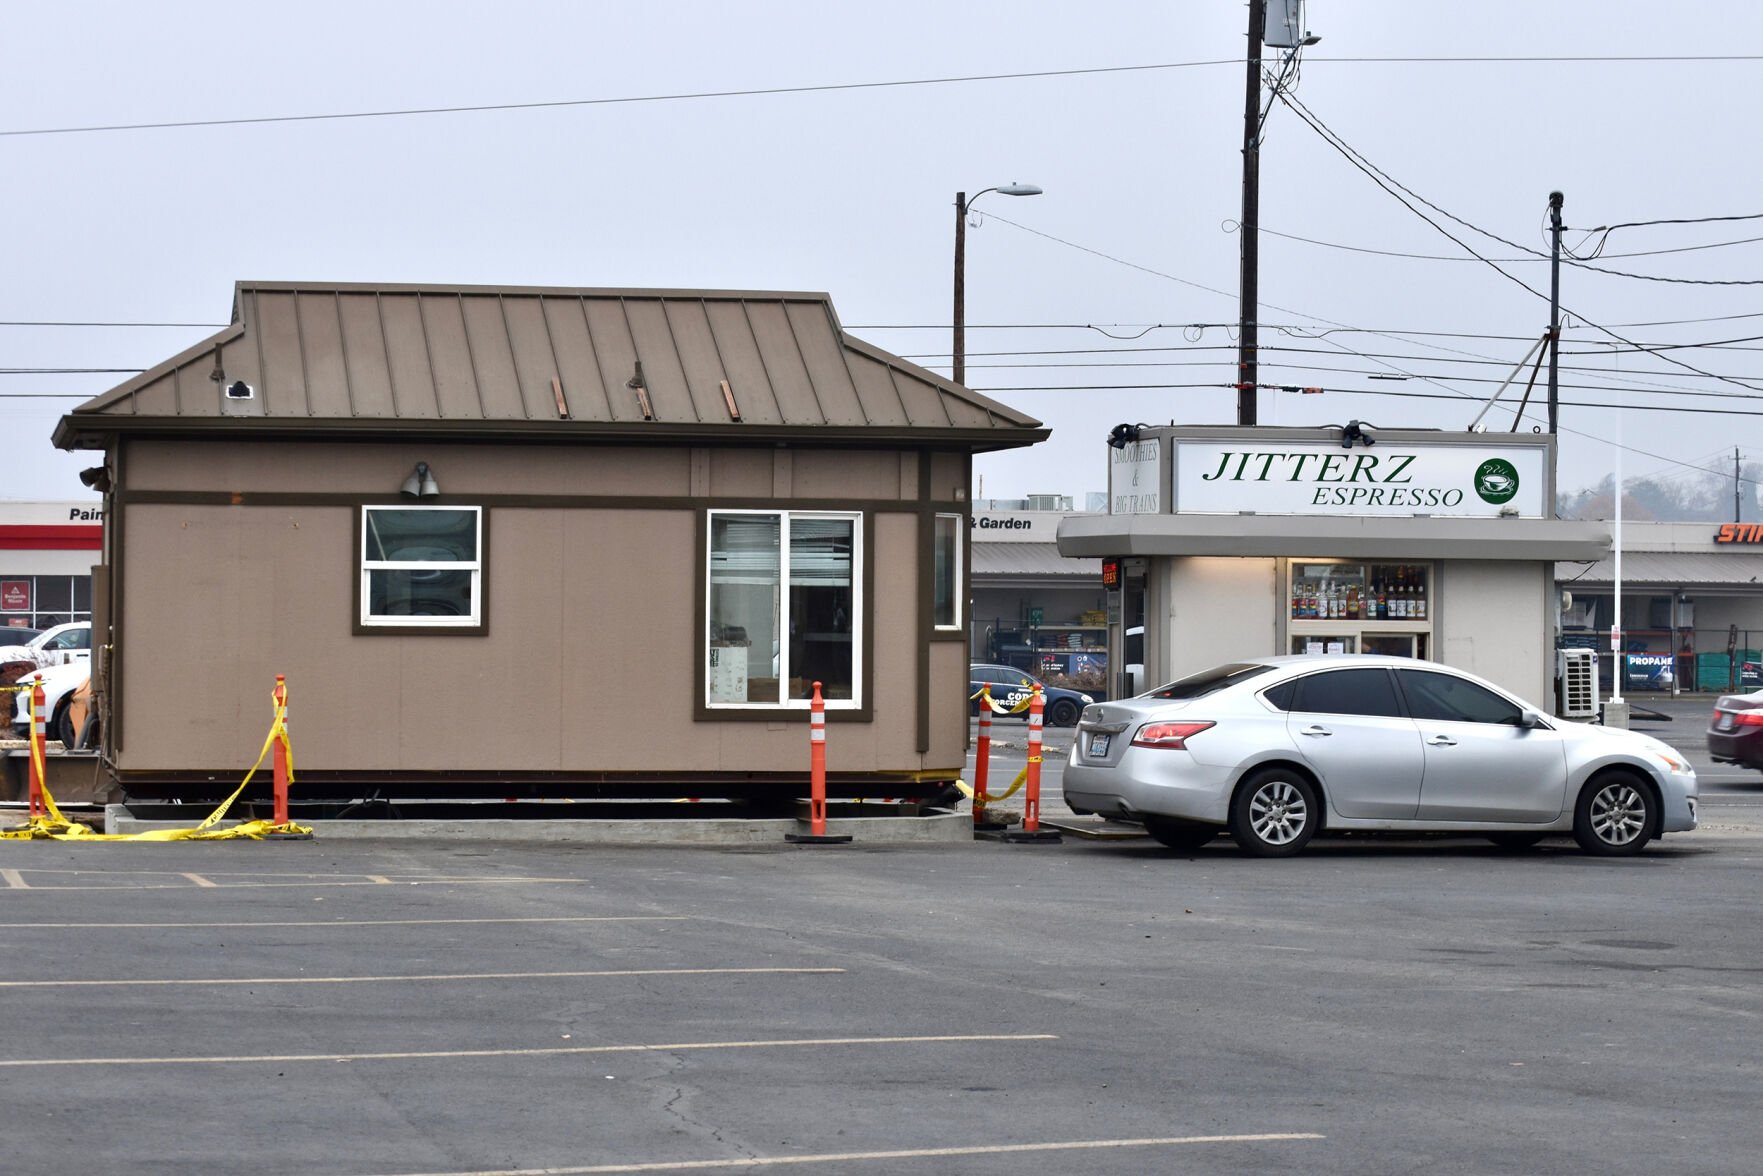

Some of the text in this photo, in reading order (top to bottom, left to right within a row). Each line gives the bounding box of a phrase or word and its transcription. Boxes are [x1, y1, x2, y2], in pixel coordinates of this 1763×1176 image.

[1202, 452, 1417, 484] JITTERZ
[1115, 494, 1158, 513] BIG TRAINS
[1311, 487, 1464, 507] ESPRESSO
[979, 517, 1032, 529] Garden
[1629, 656, 1673, 665] PROPANE
[1007, 692, 1034, 701] COD
